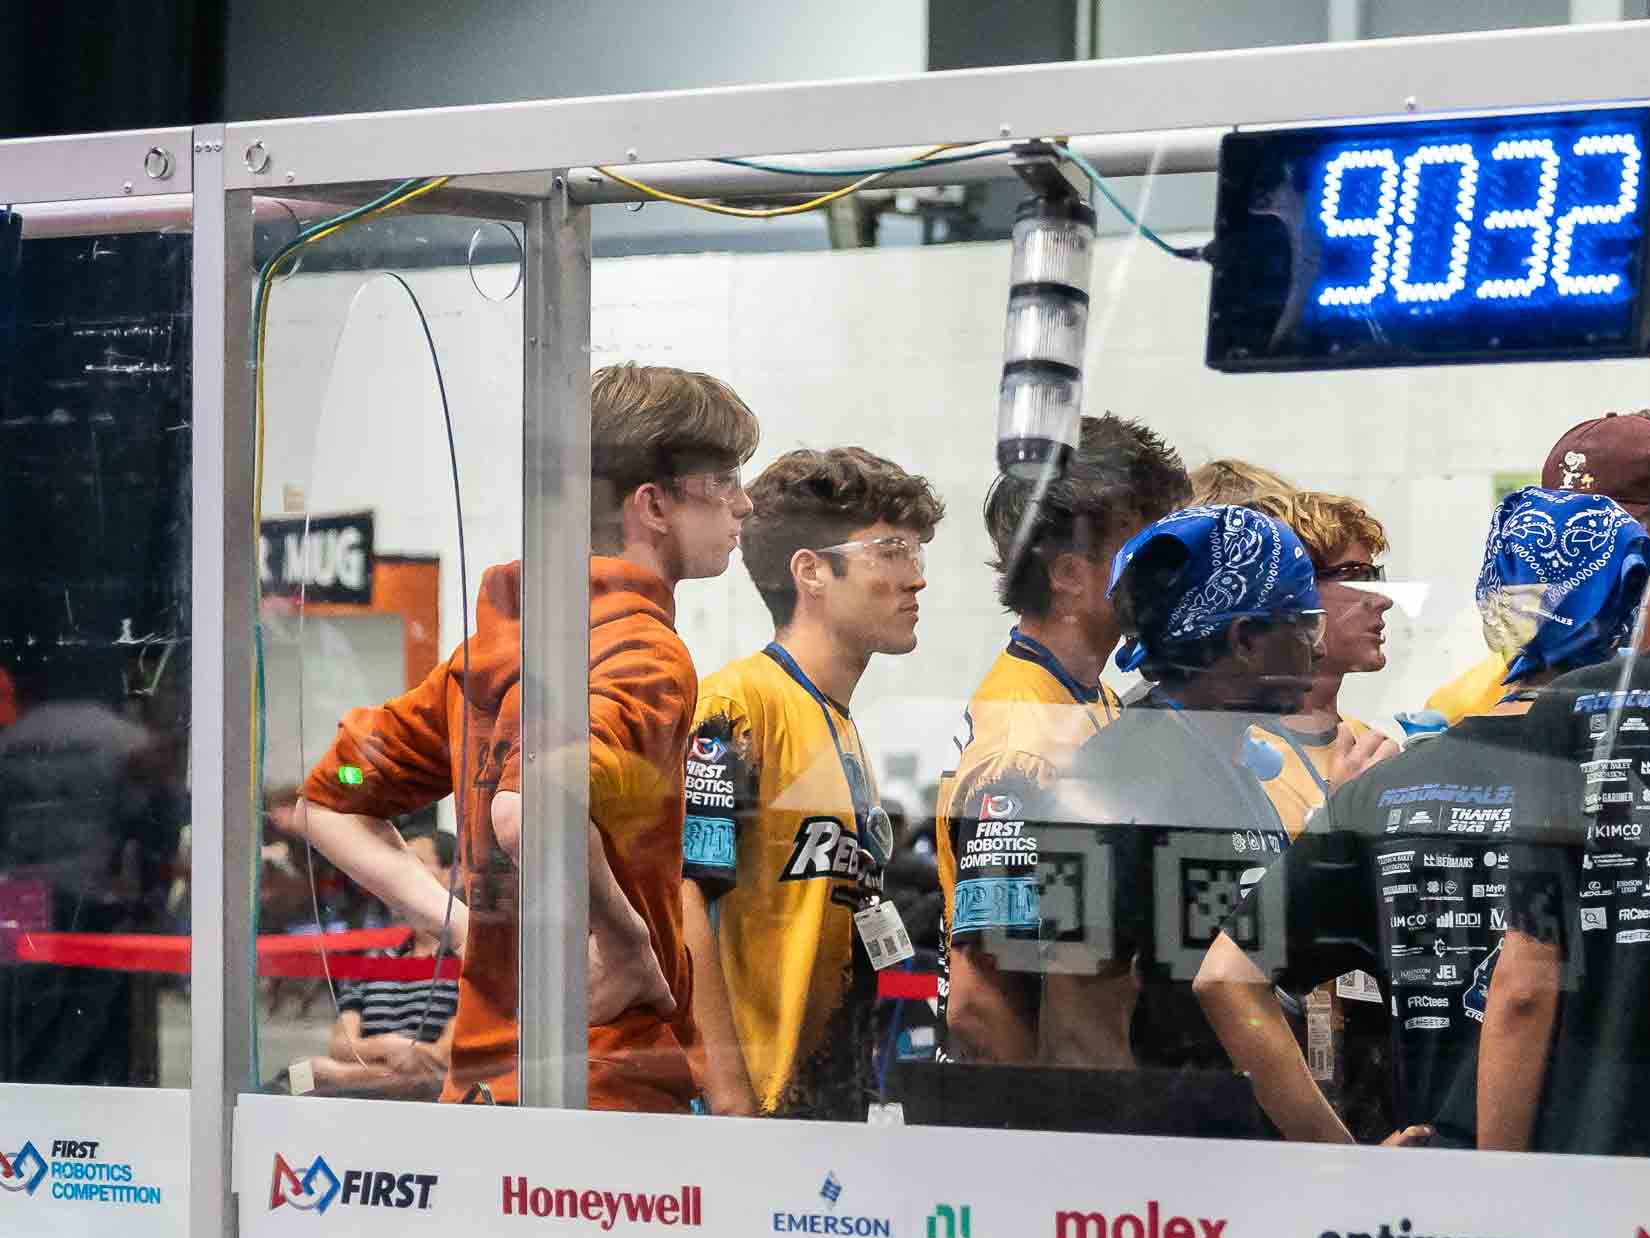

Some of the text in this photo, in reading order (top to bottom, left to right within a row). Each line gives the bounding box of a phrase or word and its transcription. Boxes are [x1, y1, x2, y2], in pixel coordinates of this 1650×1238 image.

[1319, 132, 1641, 305] 9032
[285, 526, 363, 588] MUG
[686, 775, 734, 794] BOTICS
[685, 790, 735, 808] PETITIO
[1450, 808, 1511, 820] THANKS
[976, 821, 1024, 838] FIRST
[1596, 824, 1641, 838] KIMCO
[967, 838, 1037, 853] ROBOTICS
[961, 853, 1038, 870] COMPETITIO
[1436, 965, 1456, 979] JEI
[1408, 996, 1449, 1008] FRCtees
[52, 1140, 99, 1158] FIRST
[51, 1163, 132, 1181] ROBOTICS
[52, 1184, 161, 1204] COMPETITION
[342, 1170, 438, 1209] FIRST
[502, 1175, 702, 1231] Honeywell
[773, 1213, 891, 1237] EMERSON
